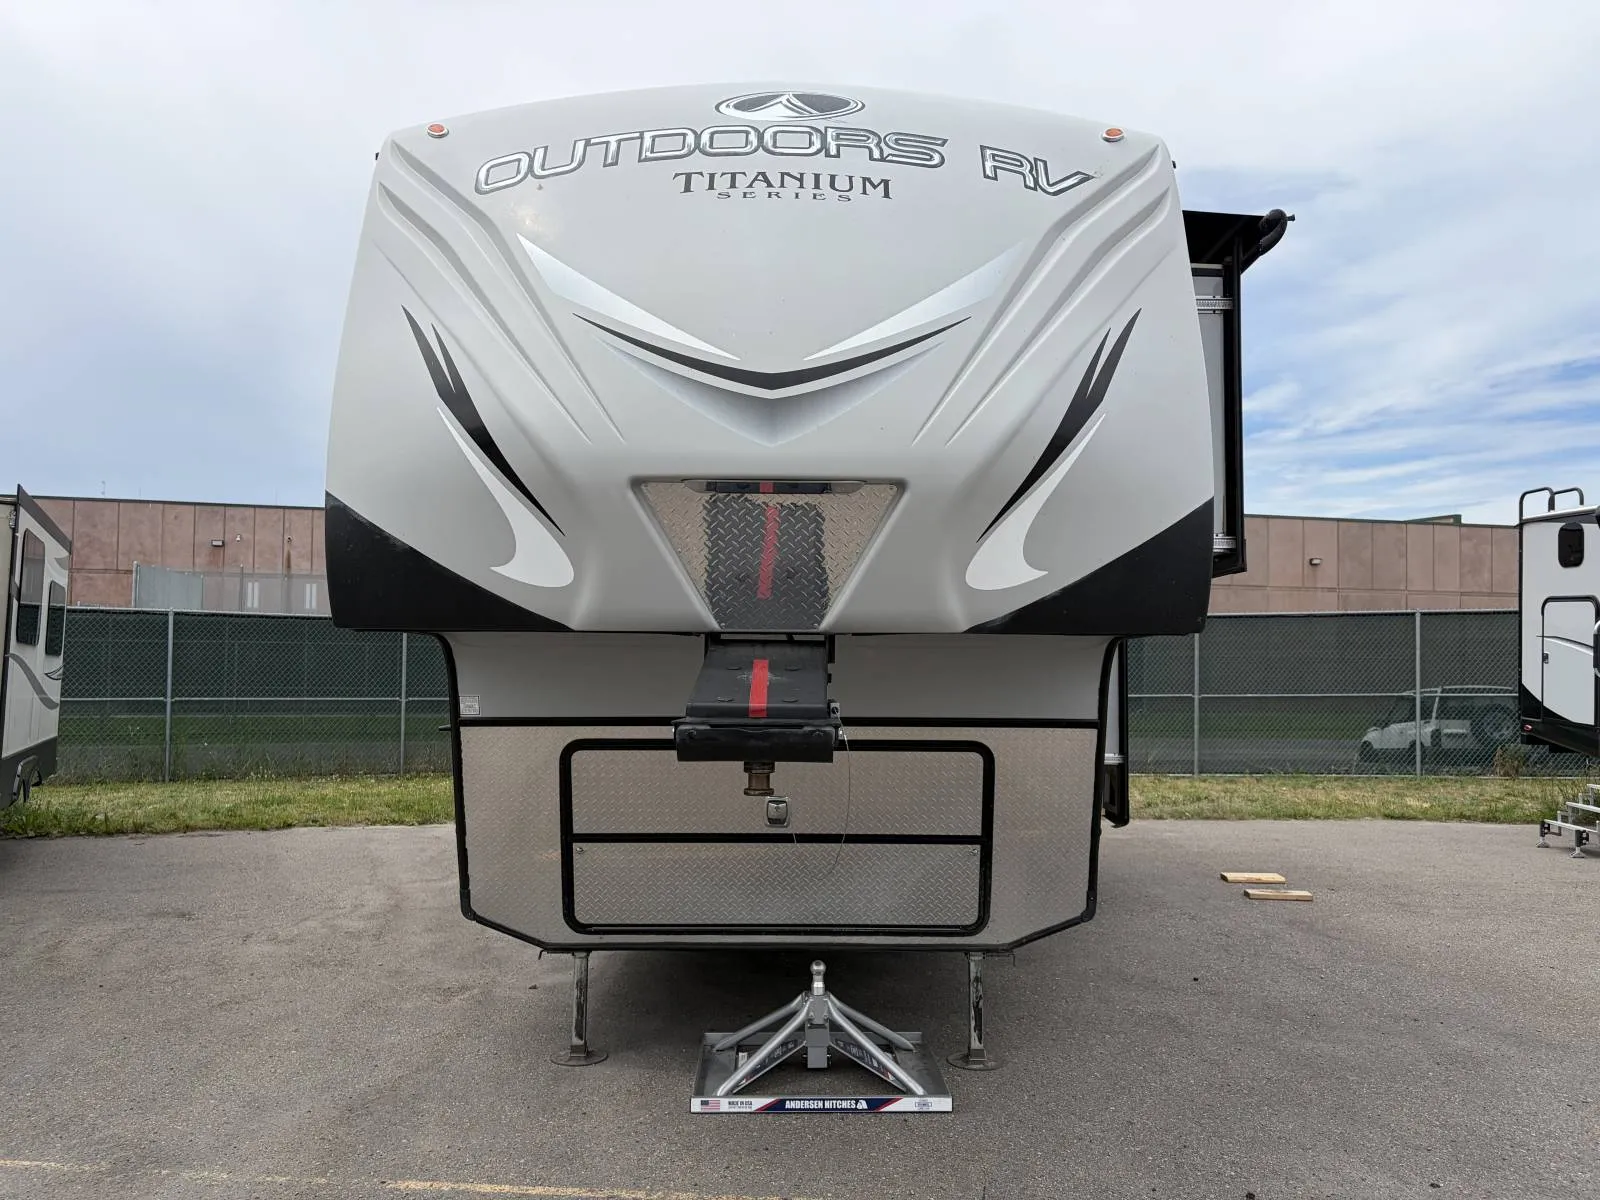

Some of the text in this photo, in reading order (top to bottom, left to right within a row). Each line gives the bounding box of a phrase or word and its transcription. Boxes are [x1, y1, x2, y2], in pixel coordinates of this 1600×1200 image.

[474, 124, 1096, 197] OUTDOORS RV
[672, 171, 893, 200] TITANIUM
[716, 191, 852, 202] SERIES
[785, 1099, 856, 1109] ANDERSEN HITCHES
